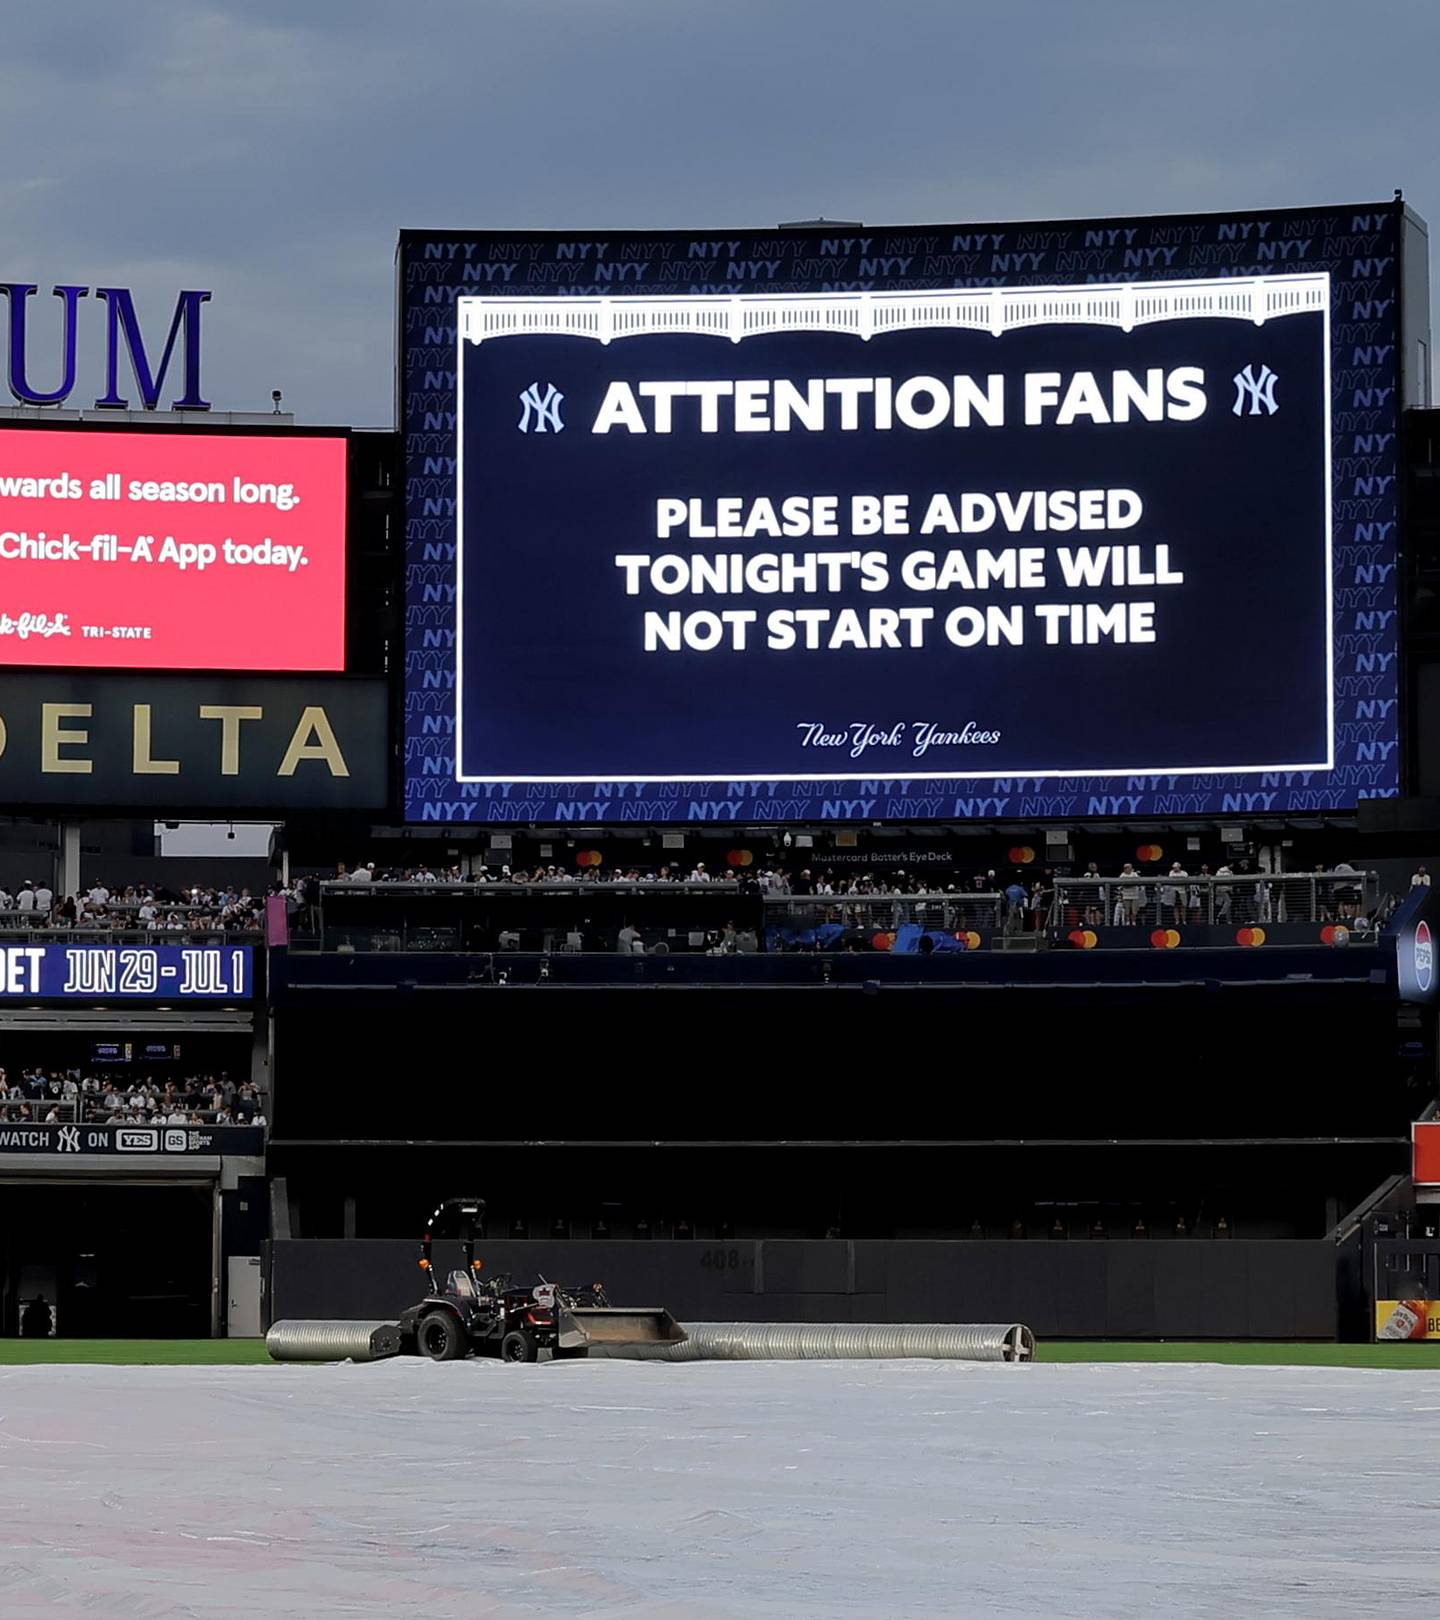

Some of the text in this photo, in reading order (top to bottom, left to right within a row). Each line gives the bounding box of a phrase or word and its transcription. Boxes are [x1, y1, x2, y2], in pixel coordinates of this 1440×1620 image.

[592, 366, 1206, 434] ATTENTION FANS
[89, 474, 121, 501] all
[128, 482, 226, 504] season
[233, 477, 301, 511] long.
[657, 489, 1143, 538] PLEASE BE ADVISED
[158, 538, 216, 571] App
[223, 540, 309, 571] today.
[615, 544, 1183, 595] TONIGHT'S GAME WILL
[82, 626, 152, 639] TRI-STATE
[644, 602, 1156, 651] NOT START ON TIME
[797, 722, 1001, 758] New York Yankees
[422, 801, 476, 821] NYY
[821, 799, 875, 818] NYY
[1222, 793, 1276, 811] NYY
[811, 853, 868, 862] Mastercard
[909, 852, 927, 862] Eye
[928, 852, 952, 861] Deck
[64, 949, 116, 992] JUN
[120, 949, 158, 993] 29
[180, 950, 228, 993] JUL
[232, 950, 244, 993] 1
[88, 1132, 108, 1147] ON
[123, 1135, 151, 1145] YES
[168, 1135, 183, 1145] GS
